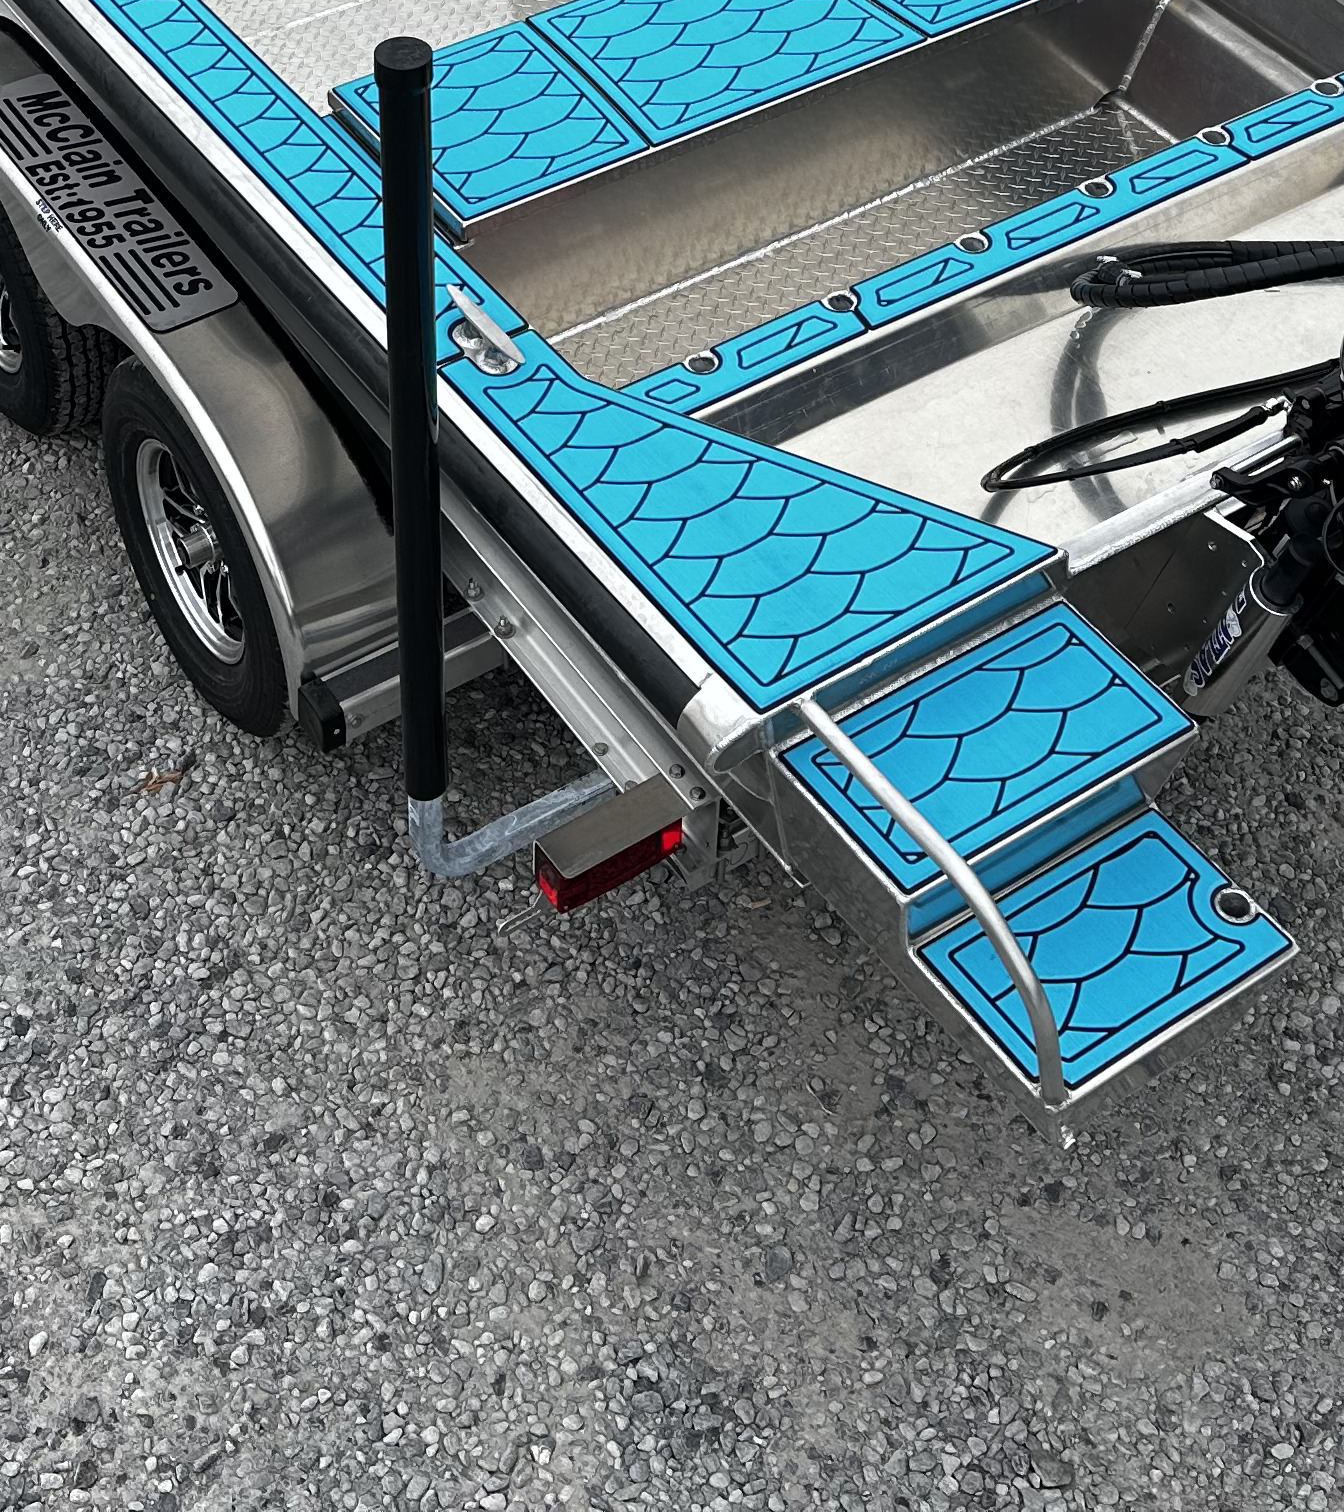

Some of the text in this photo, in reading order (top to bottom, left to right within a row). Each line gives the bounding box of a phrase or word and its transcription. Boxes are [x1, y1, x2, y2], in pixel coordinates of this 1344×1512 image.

[17, 90, 213, 296] McClain Trailers
[36, 198, 50, 214] STEP
